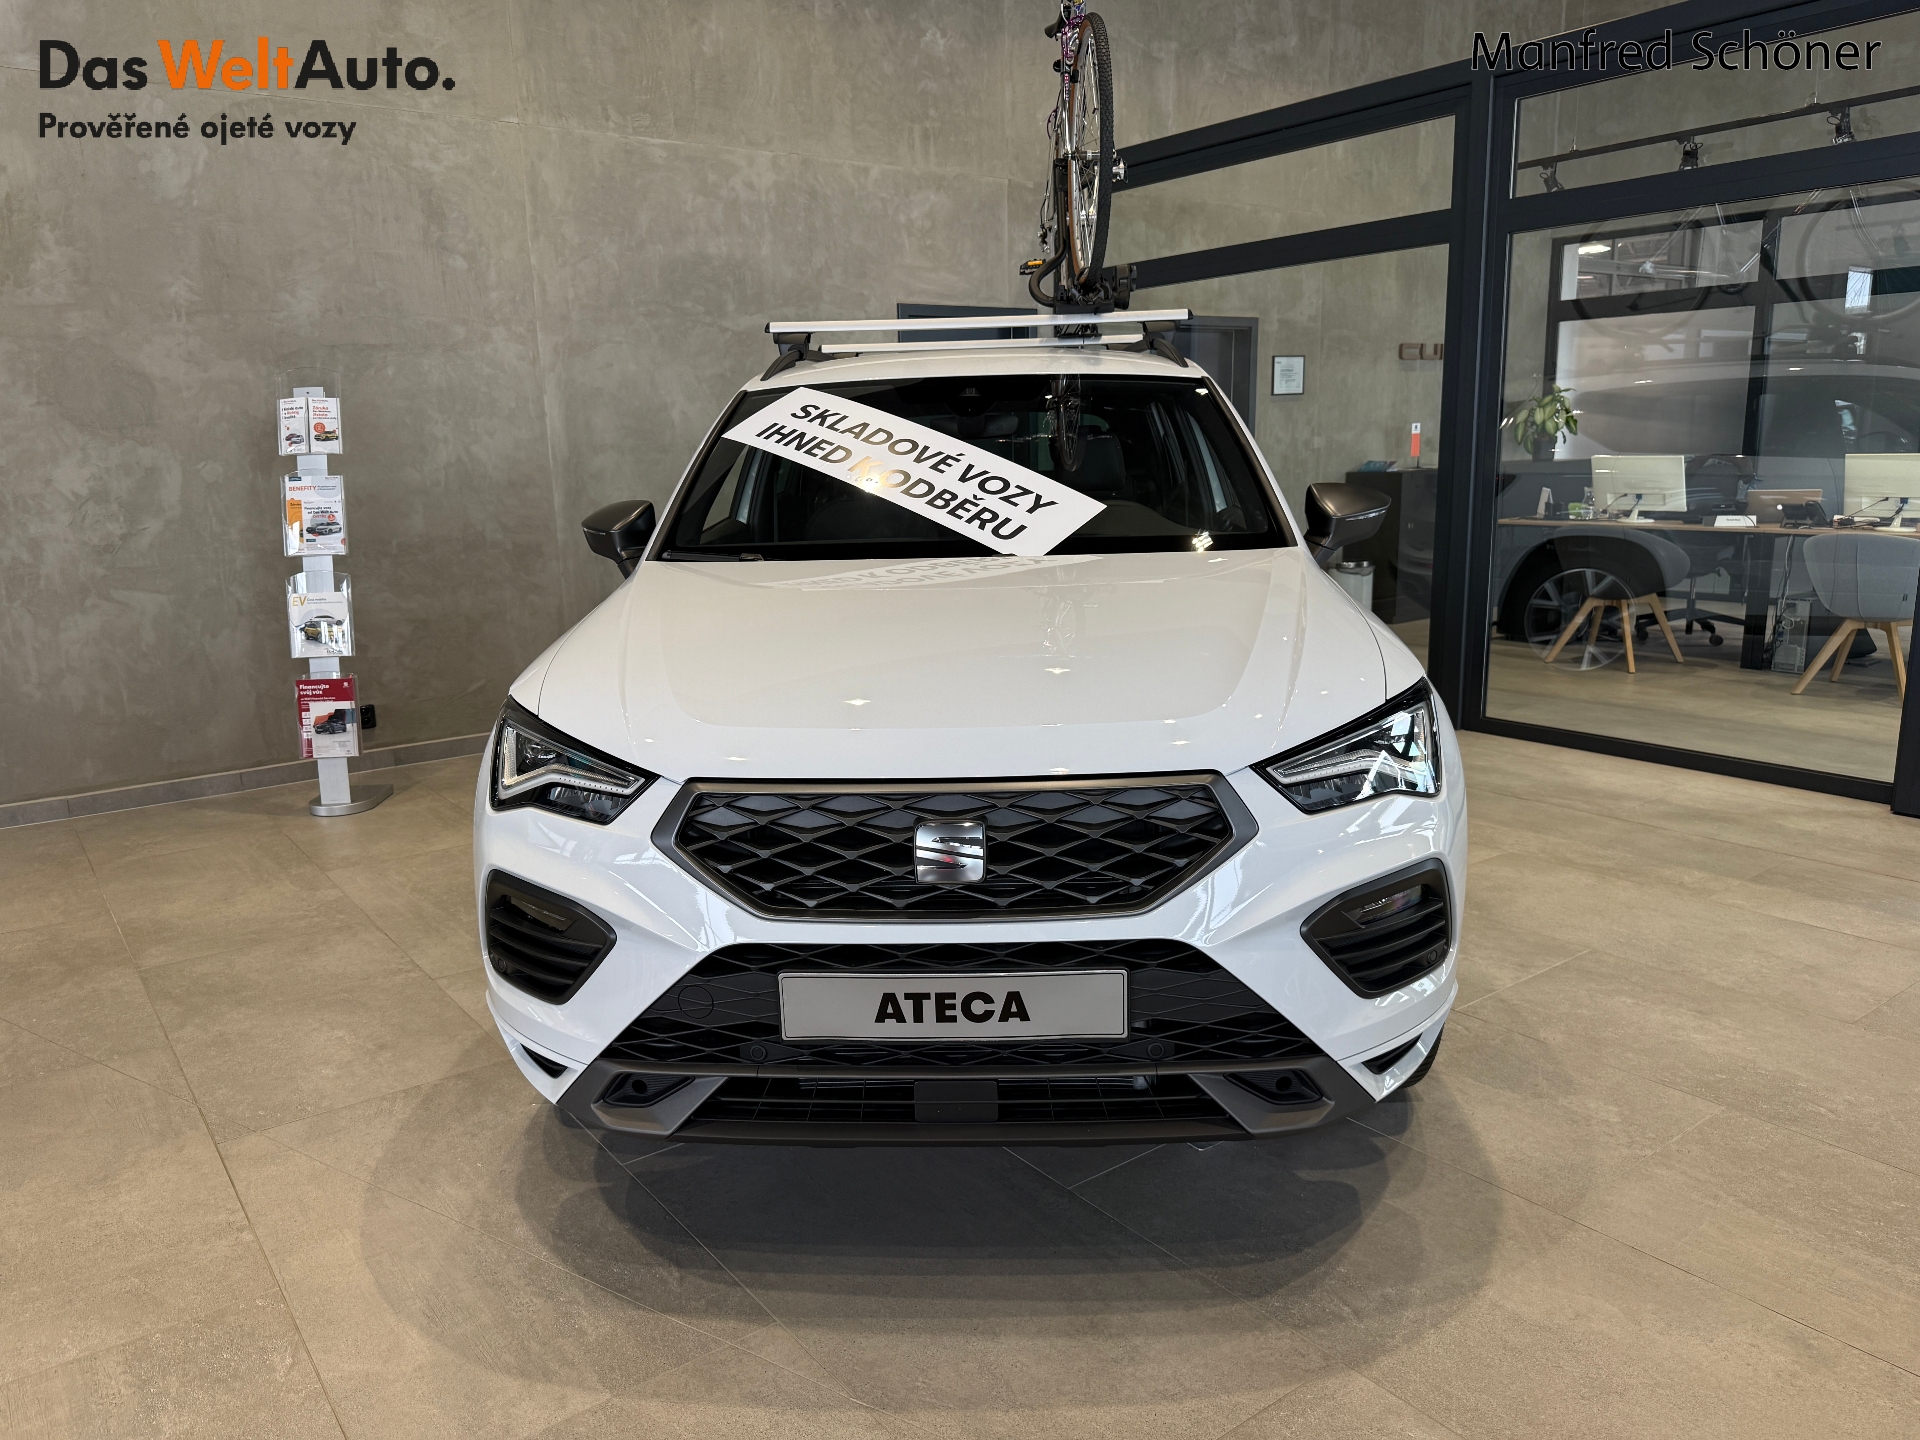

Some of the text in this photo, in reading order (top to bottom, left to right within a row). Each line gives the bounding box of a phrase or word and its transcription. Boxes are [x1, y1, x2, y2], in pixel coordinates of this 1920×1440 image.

[755, 422, 1028, 541] IHNED K ODBĚRU
[790, 403, 1060, 515] SKLADOVÉ VOZY
[292, 596, 307, 607] EV
[874, 990, 1031, 1024] ATECA
